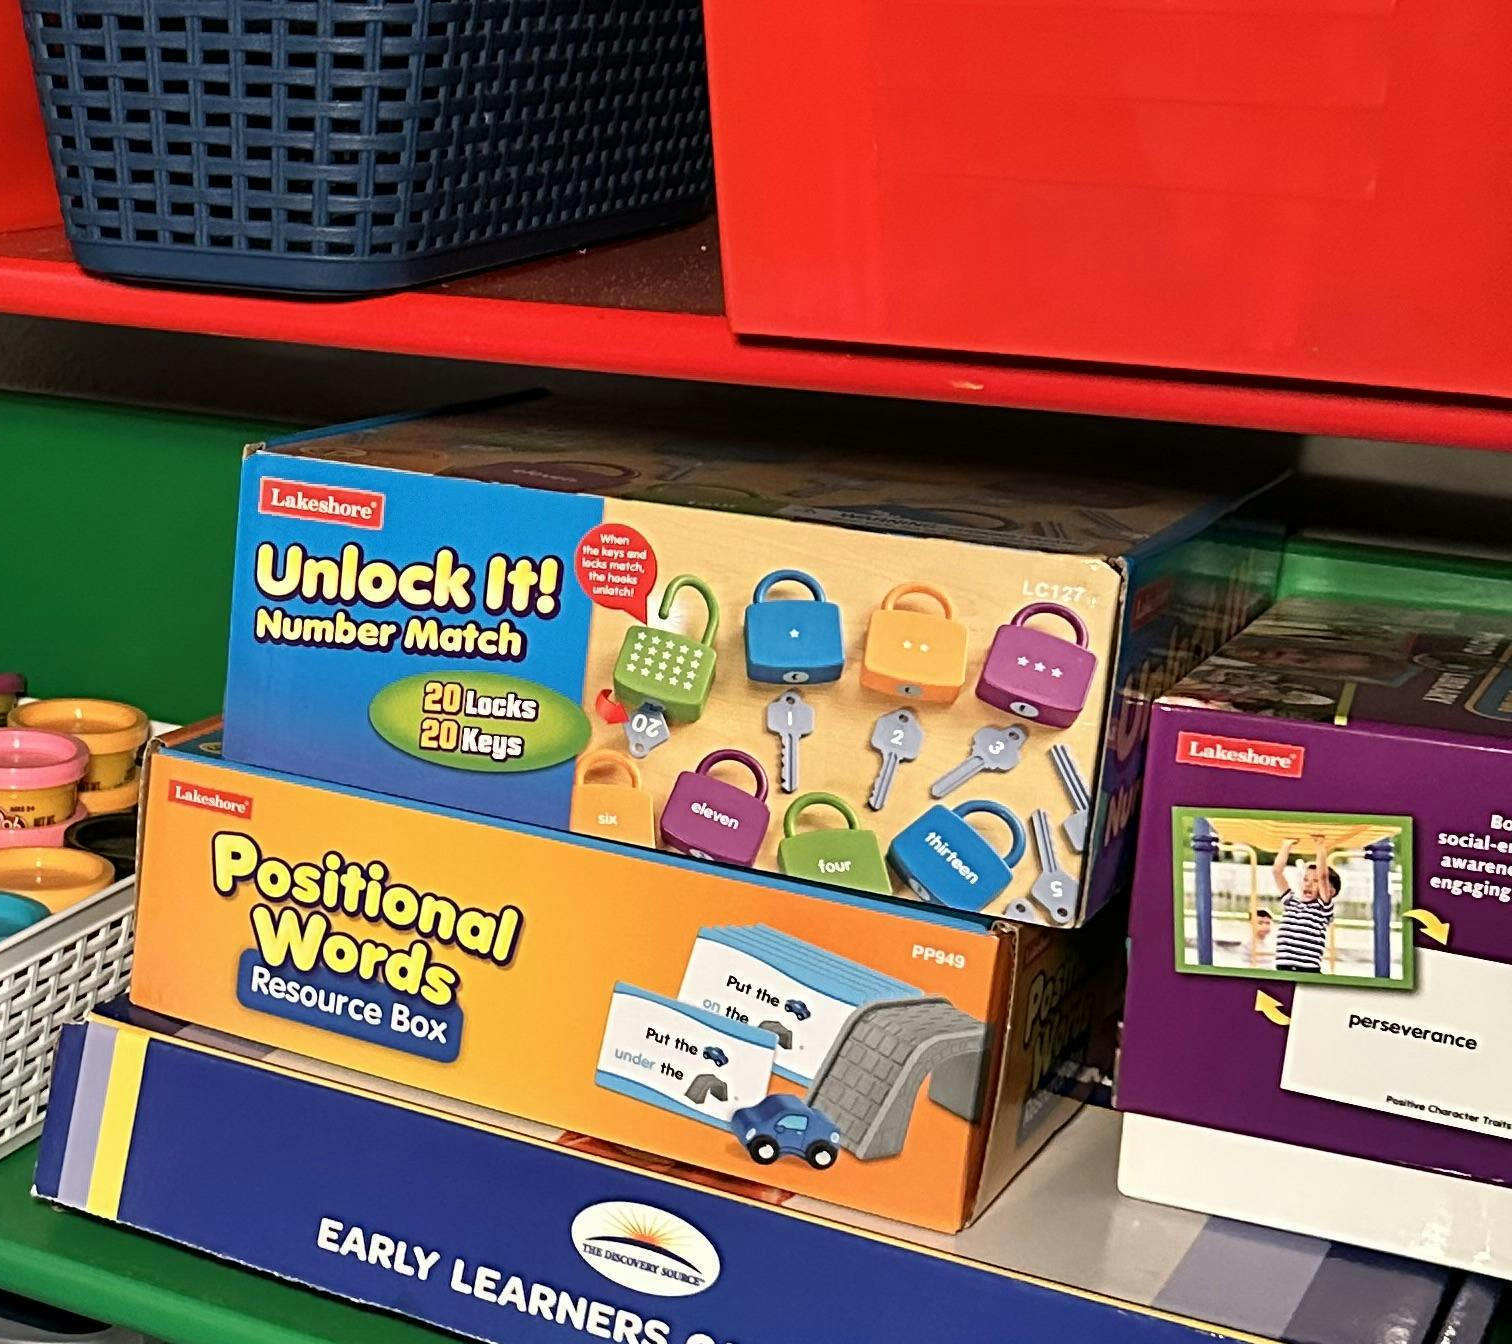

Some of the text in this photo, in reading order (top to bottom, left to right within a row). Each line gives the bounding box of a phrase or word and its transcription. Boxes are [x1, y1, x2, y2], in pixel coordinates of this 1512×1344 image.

[270, 488, 374, 520] Lakeshore
[582, 545, 647, 560] the keys and
[600, 533, 630, 546] When
[255, 542, 559, 614] Unlock It!
[581, 557, 607, 570] locks
[589, 571, 606, 582] the
[1022, 579, 1086, 604] LC127
[255, 607, 523, 657] Number Match
[423, 681, 538, 721] 20 Locks
[420, 718, 524, 761] 20 Keys
[890, 729, 905, 746] 2
[988, 740, 1005, 755] 3
[1189, 741, 1293, 769] Lakeshore
[174, 785, 247, 814] Lakeshore
[597, 811, 618, 825] six
[690, 801, 740, 831] eleven
[1491, 814, 1512, 832] Bo
[817, 858, 852, 874] four
[924, 830, 980, 885] thirteen
[212, 833, 519, 963] Positional
[1430, 877, 1512, 903] engaging
[251, 905, 458, 1006] Words
[911, 943, 967, 970] PP949
[251, 966, 448, 1045] Resource Box
[726, 976, 780, 1008] Put the
[702, 996, 750, 1026] on the
[645, 1027, 699, 1057] Put the
[1348, 1012, 1478, 1051] perseverance
[614, 1048, 684, 1082] under the
[1386, 1094, 1512, 1131] Positive Character Traits
[316, 1218, 441, 1281] EARLY
[583, 1243, 701, 1287] THE DISCOVERY SOURCE
